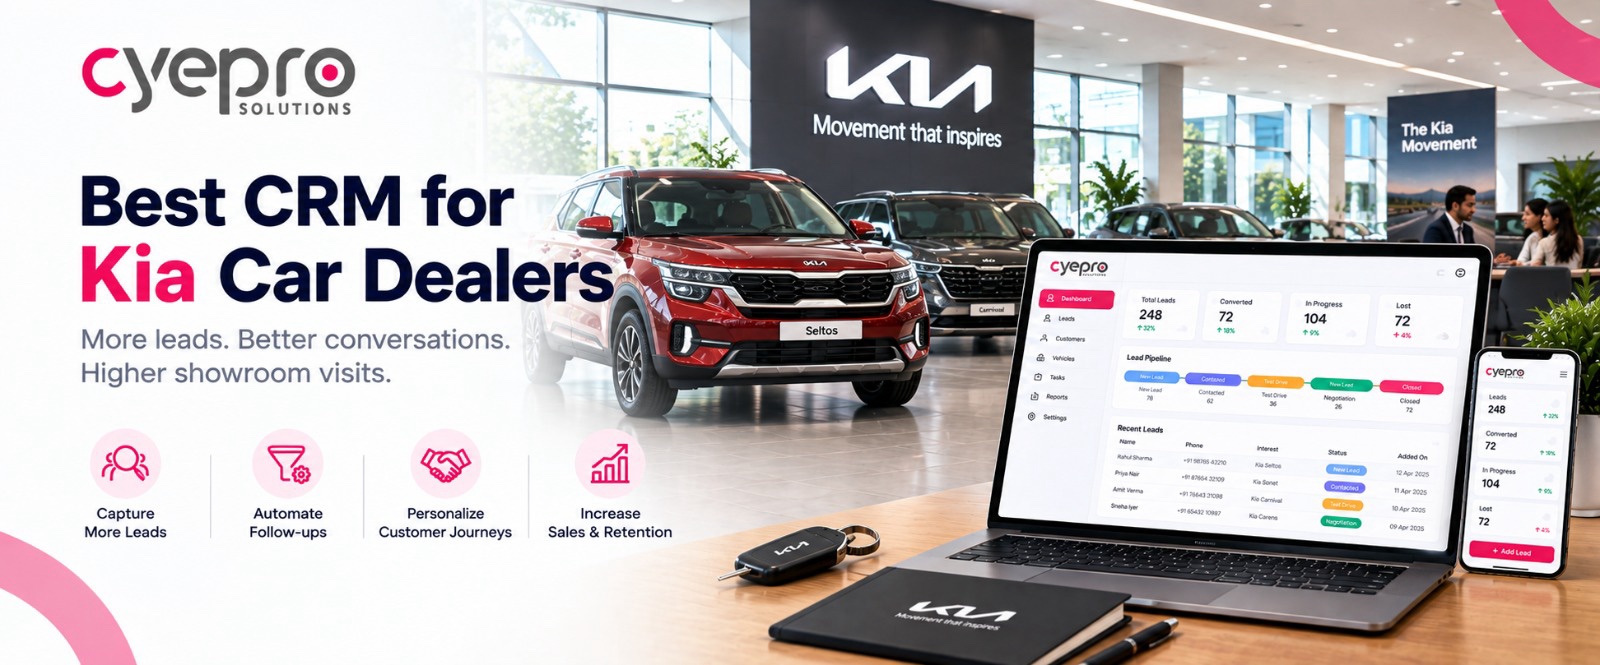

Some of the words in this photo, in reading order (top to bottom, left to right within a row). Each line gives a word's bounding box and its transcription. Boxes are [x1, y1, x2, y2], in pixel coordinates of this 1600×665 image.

[813, 113, 906, 141] Movement
[909, 123, 942, 144] that
[946, 126, 1002, 149] inspires
[1401, 123, 1427, 136] The
[1430, 121, 1453, 135] Kia
[1402, 136, 1477, 153] Movement
[1050, 260, 1108, 277] cyepro
[1220, 298, 1253, 306] Converted
[1139, 309, 1162, 320] 248
[1219, 311, 1233, 322] 72
[1304, 313, 1327, 324] 104
[1395, 315, 1410, 327] 72
[806, 325, 838, 336] Seltos
[1127, 354, 1144, 362] Lead
[1145, 354, 1172, 363] Pipeline
[1485, 367, 1525, 379] cyepro
[1488, 405, 1506, 414] 248
[1043, 414, 1067, 422] Settings
[1117, 424, 1141, 433] Recent
[1142, 426, 1164, 434] Leads
[1485, 430, 1517, 438] Converted
[1485, 441, 1496, 451] 72
[1482, 479, 1500, 489] 104
[1478, 517, 1490, 526] 72
[1501, 548, 1515, 556] Add
[1515, 549, 1532, 557] Lead
[894, 612, 944, 624] Movement
[963, 621, 1000, 631] inspires
